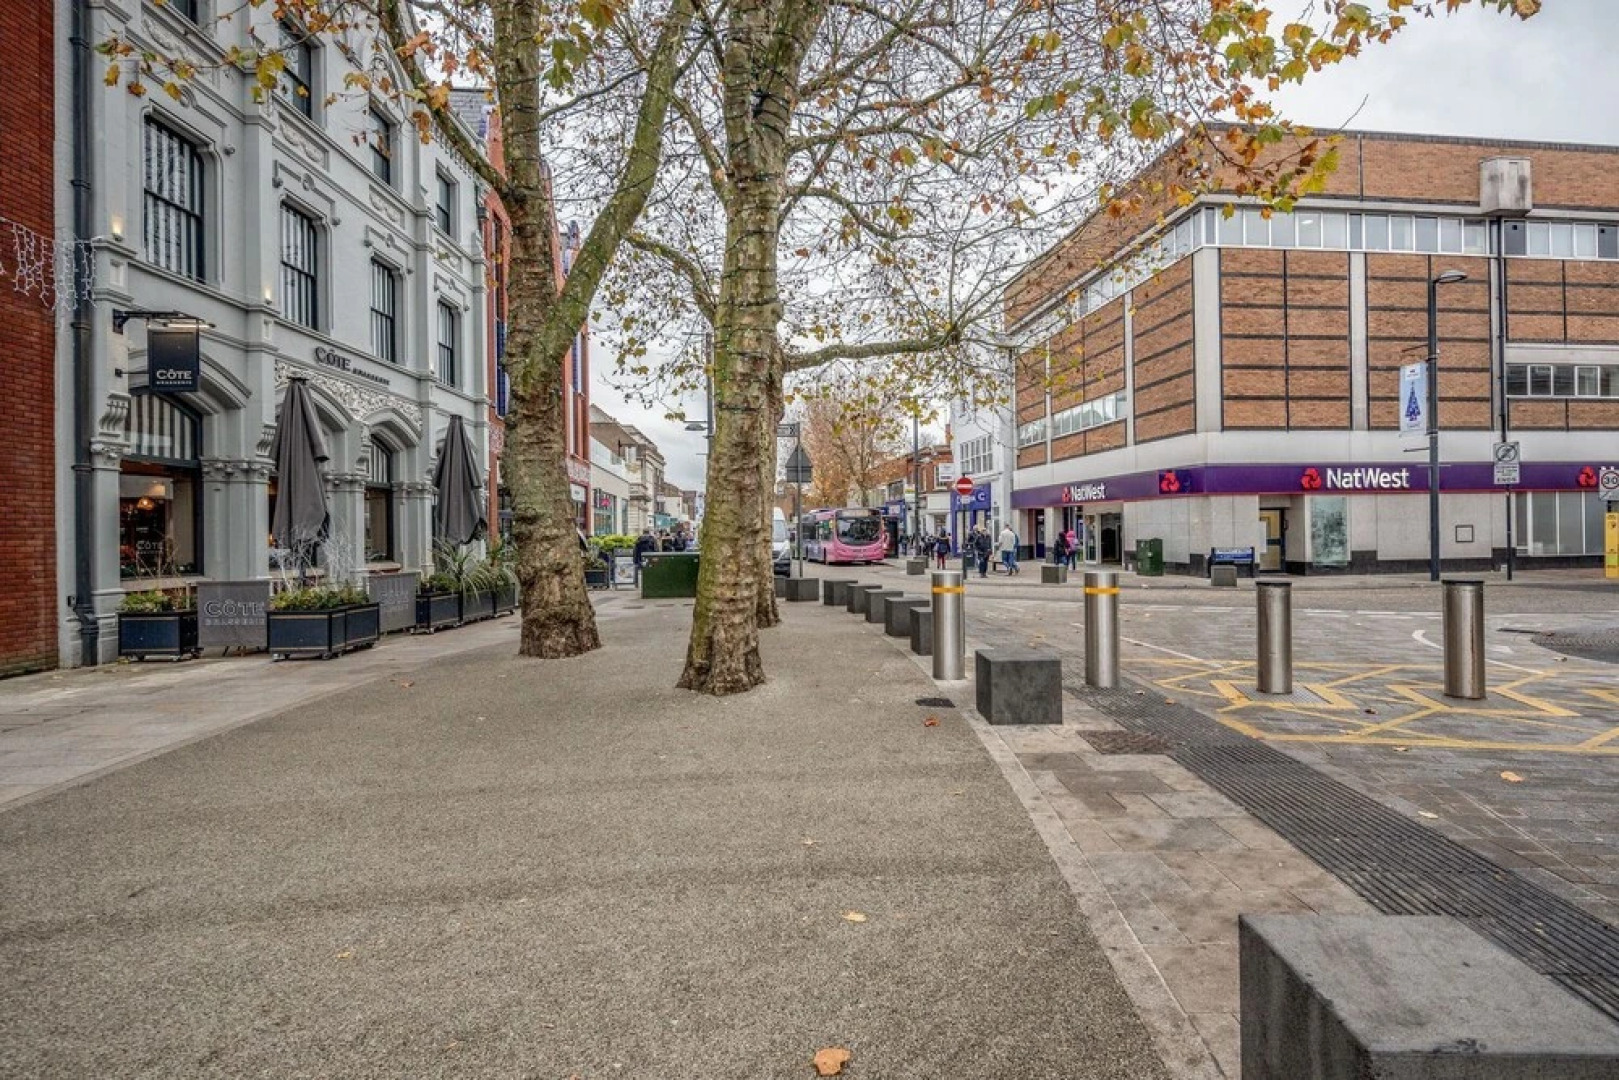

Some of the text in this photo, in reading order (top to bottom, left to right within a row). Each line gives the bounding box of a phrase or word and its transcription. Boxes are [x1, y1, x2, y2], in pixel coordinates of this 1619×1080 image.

[314, 347, 351, 372] CÔTE
[156, 368, 192, 379] CÔTE
[1326, 467, 1410, 488] NatWest
[1070, 482, 1105, 502] NatWest
